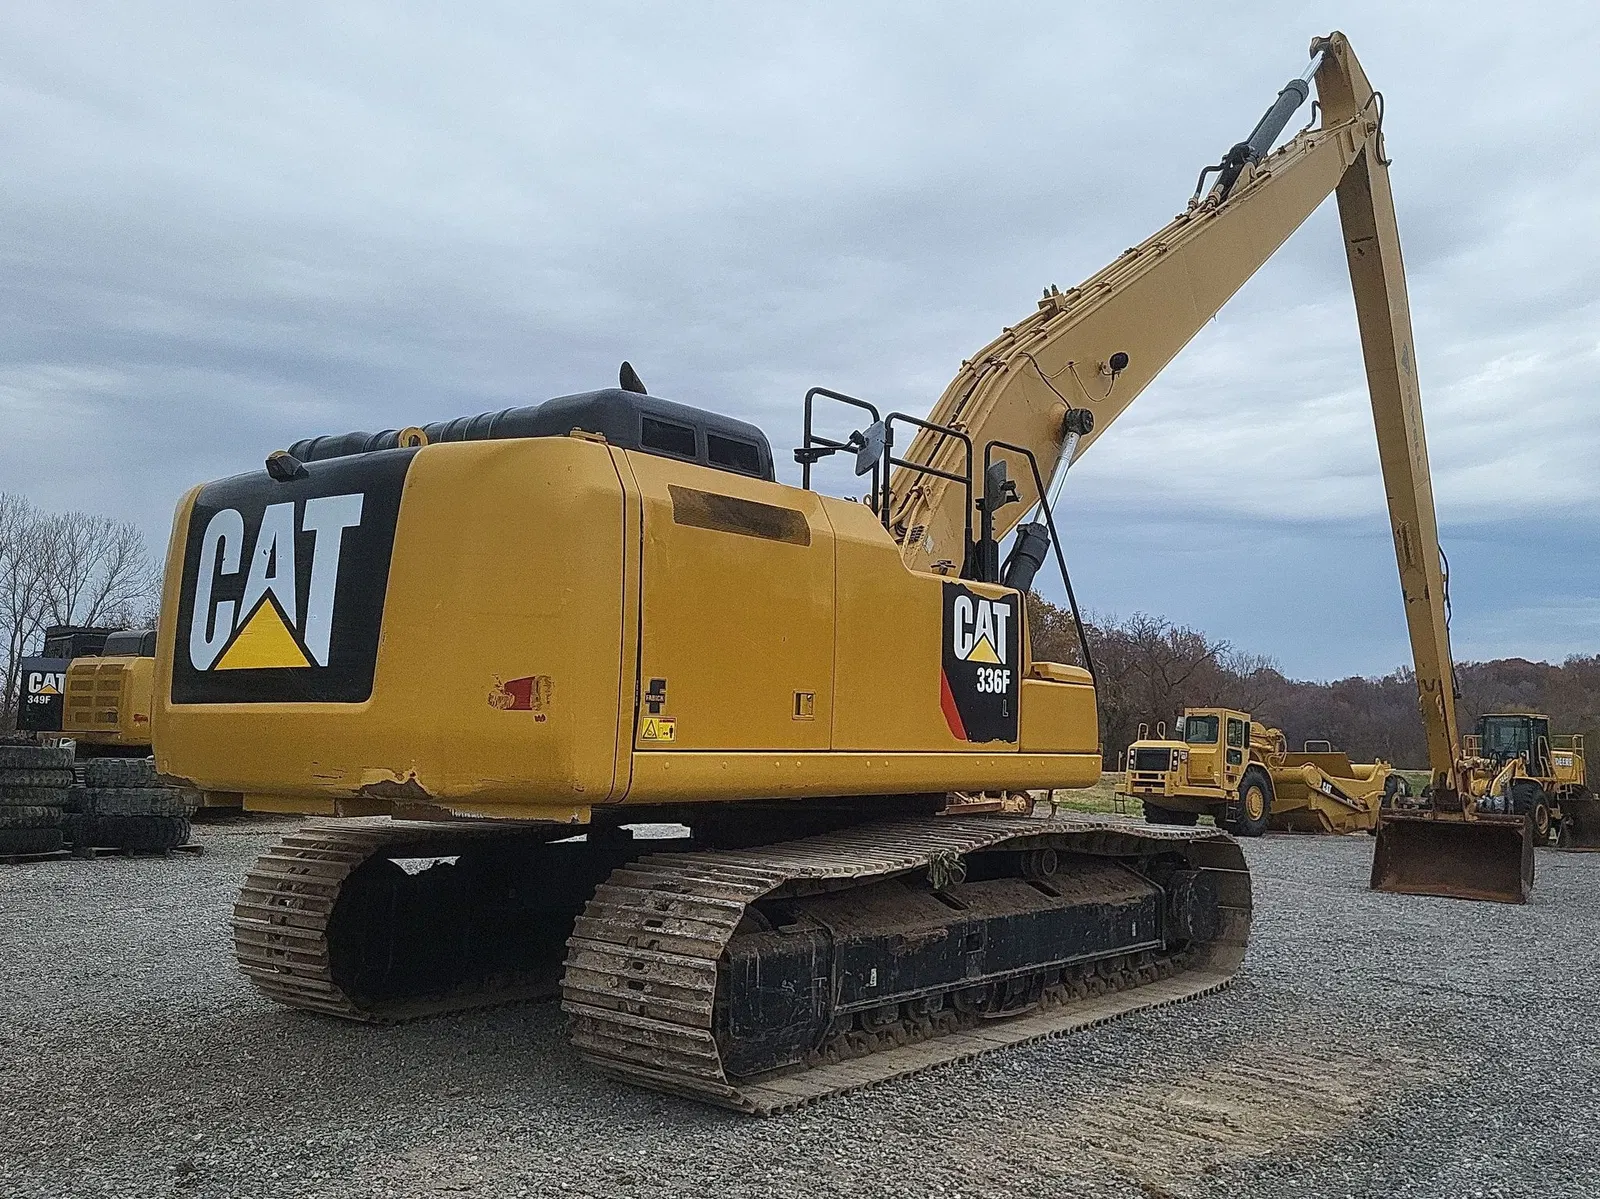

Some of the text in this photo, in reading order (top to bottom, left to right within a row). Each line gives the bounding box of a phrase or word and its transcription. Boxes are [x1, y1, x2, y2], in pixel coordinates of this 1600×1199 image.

[190, 493, 365, 671] CAT
[954, 595, 1010, 665] CAT
[28, 672, 66, 695] CAT
[976, 667, 1011, 694] 336F
[27, 695, 51, 704] 349F
[1002, 699, 1009, 717] L
[1554, 757, 1573, 767] DEERE
